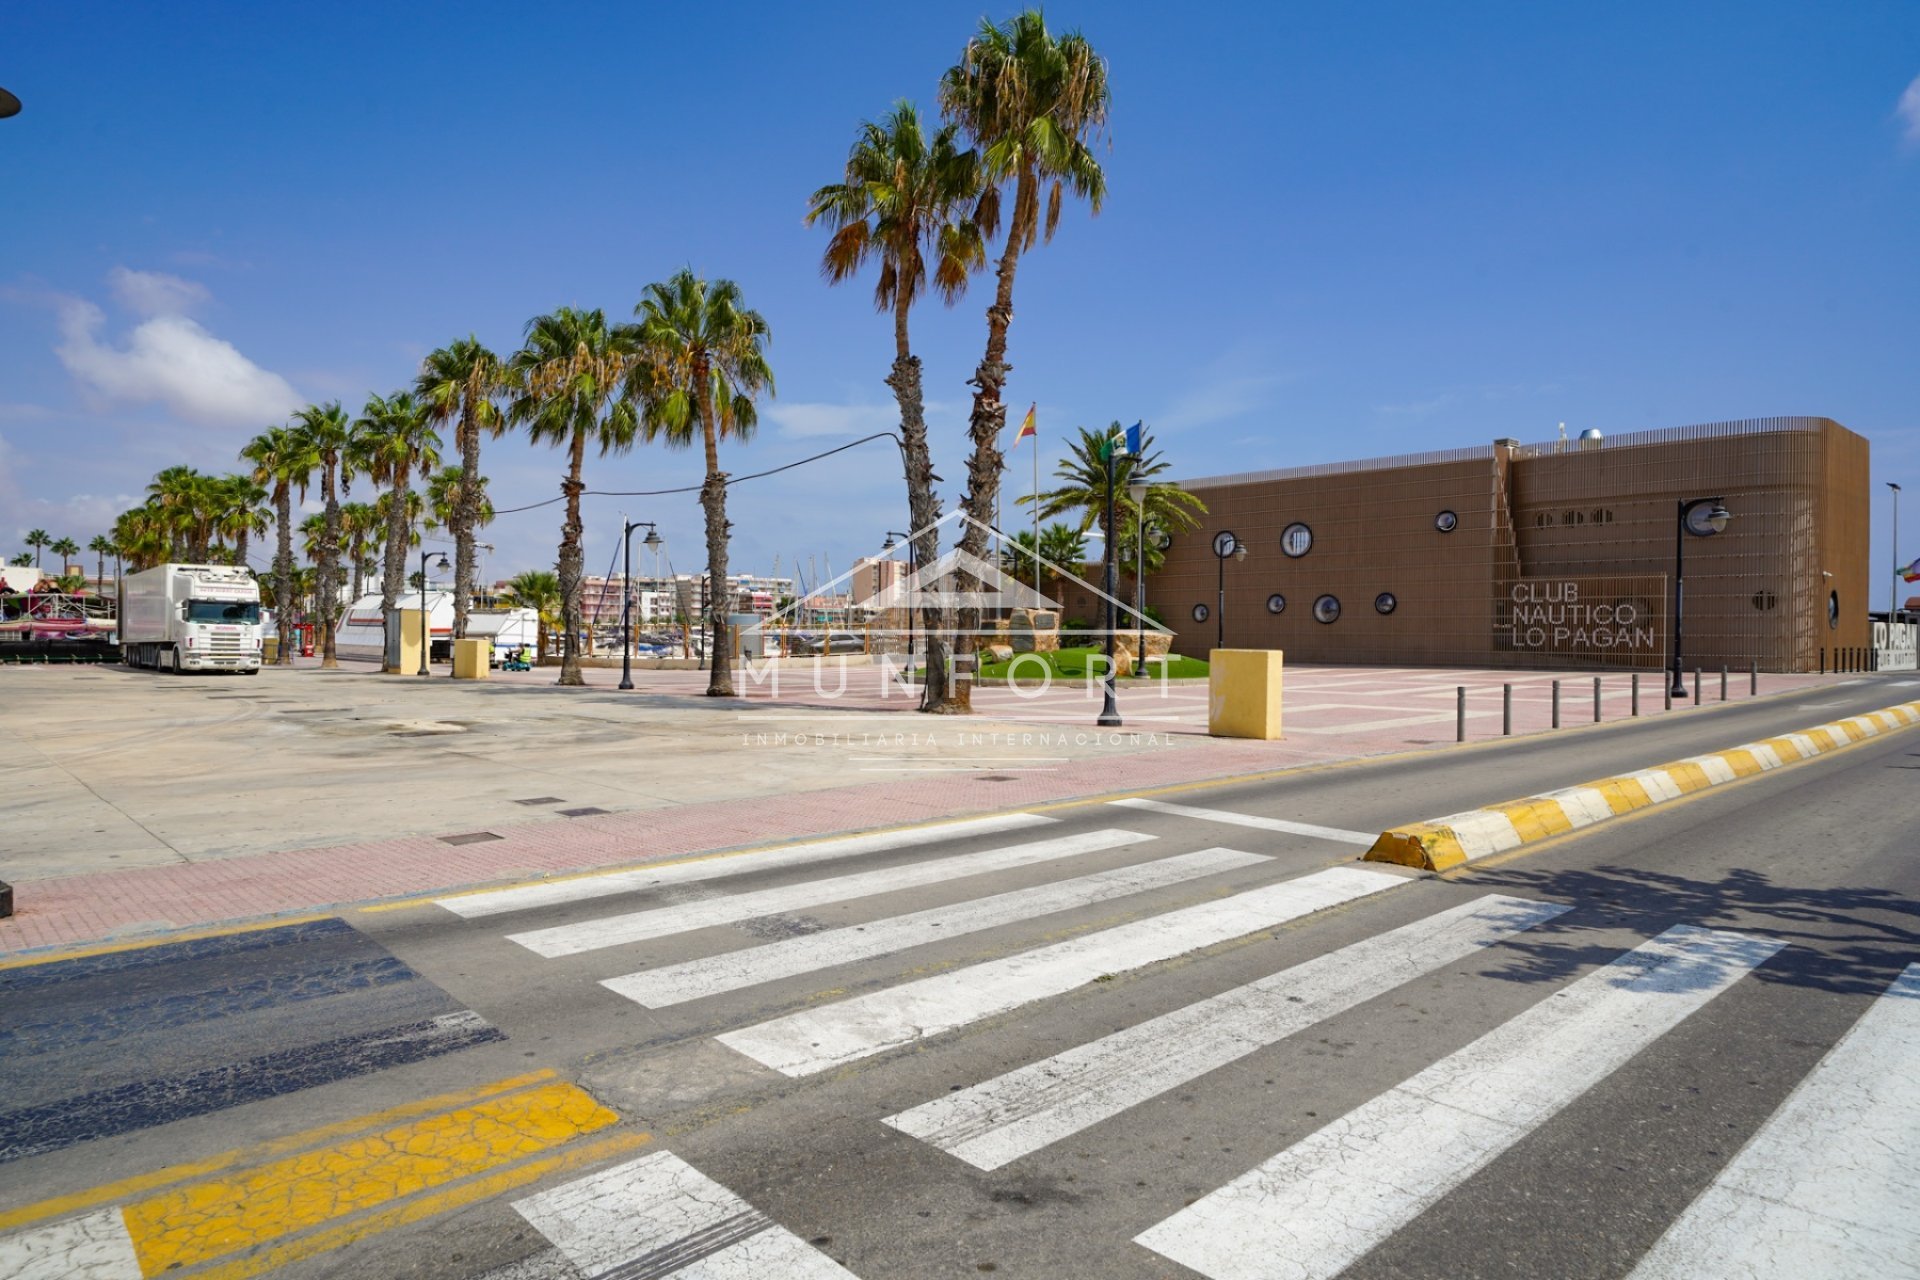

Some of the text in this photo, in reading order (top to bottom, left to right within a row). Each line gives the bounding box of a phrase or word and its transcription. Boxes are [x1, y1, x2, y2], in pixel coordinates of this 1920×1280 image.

[1512, 583, 1578, 602] CLUB
[1513, 605, 1636, 625] NAUTICO
[1513, 627, 1653, 648] LO PAGAN
[1874, 622, 1887, 650] LO
